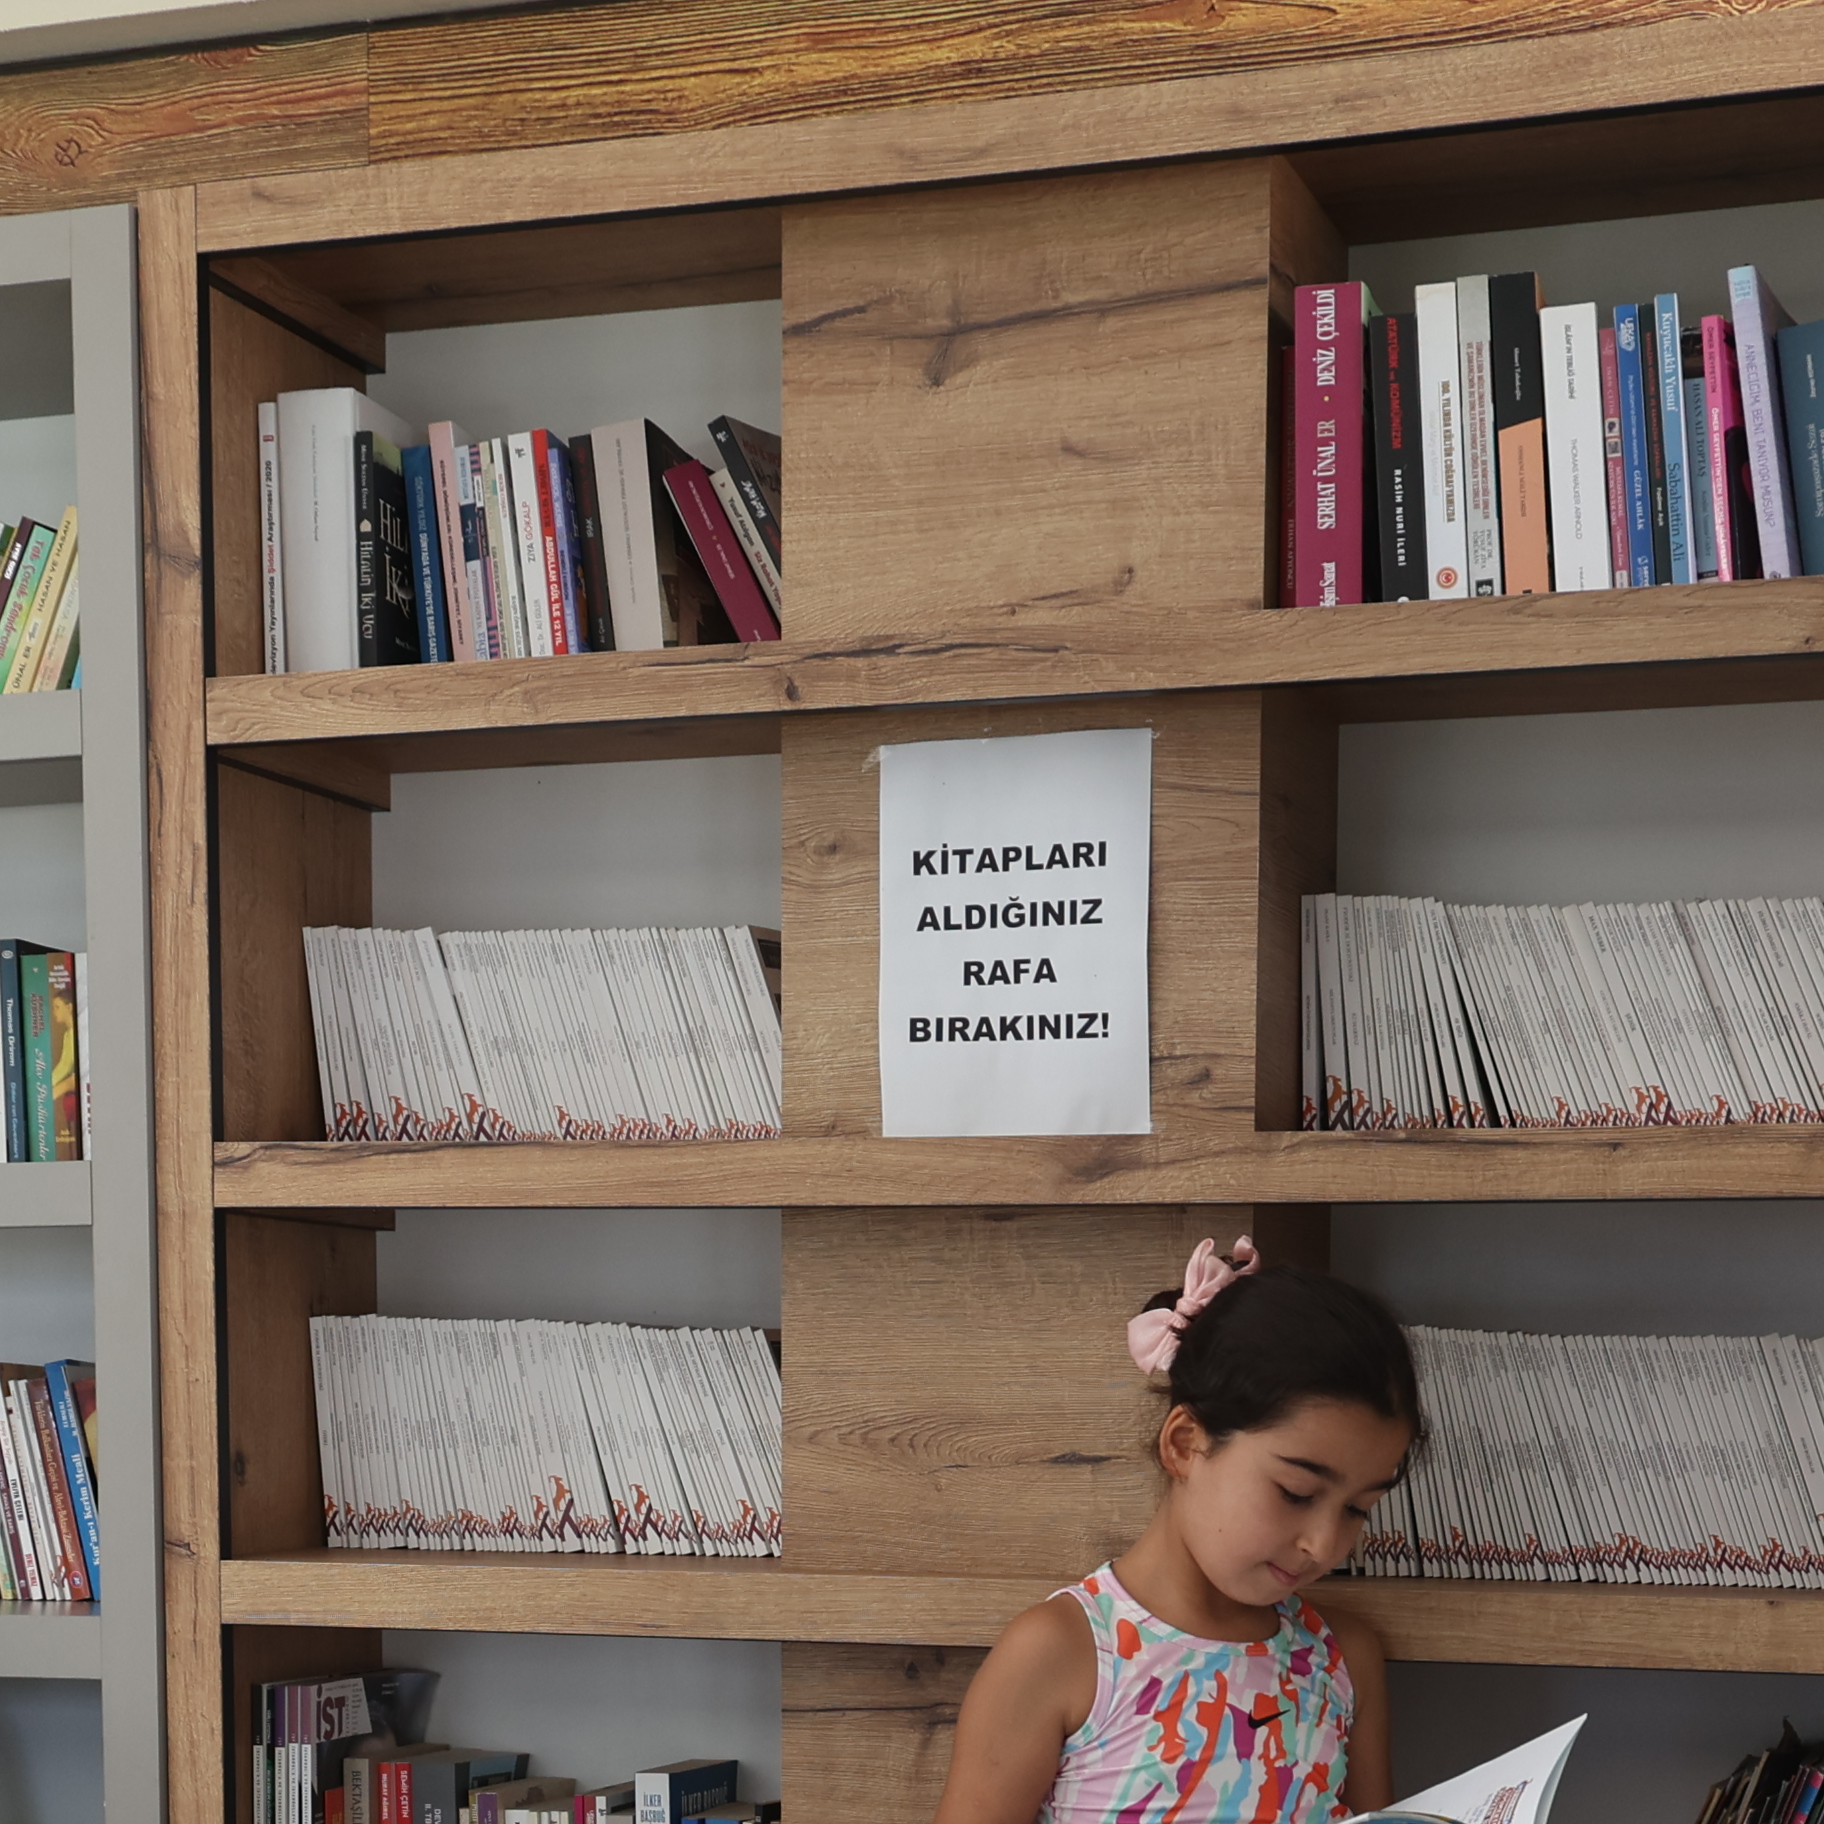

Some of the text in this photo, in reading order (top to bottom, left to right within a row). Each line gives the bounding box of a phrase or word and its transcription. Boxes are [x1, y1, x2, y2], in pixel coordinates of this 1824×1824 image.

[1311, 288, 1340, 386] DENİZ ÇEKİLDİ
[1387, 317, 1402, 449] ATATÜRK KOMÜNİZM
[1660, 312, 1679, 412] Kuyucaklı Yusuf
[1692, 383, 1708, 478] HASAN ALİ TOPTAŞ
[1711, 407, 1721, 431] ÖMER
[1312, 419, 1336, 530] SERHAT ÜNAL ER
[1570, 438, 1579, 473] THOMAS
[1754, 438, 1771, 482] TANIYOR
[521, 501, 534, 541] GÖKALP
[1393, 469, 1407, 567] RASİH NURİ İLERİ
[1633, 470, 1646, 530] GÜZEL AHLÂK
[1668, 462, 1685, 562] Sabahattin Ali
[585, 517, 594, 538] IRAK
[728, 496, 742, 519] Yusuf
[753, 550, 765, 564] Siz
[759, 563, 775, 588] Rahat
[1573, 505, 1583, 539] ARNOLD
[37, 520, 72, 613] HASAN VE HASAN
[265, 460, 278, 632] Yayınlarında Şiddet Araştırması 2020
[545, 535, 565, 646] ABDULLAH GÜL İLE 12 YIL
[13, 645, 33, 689] ÜNAL ER
[912, 841, 1107, 876] KİTAPLARI
[916, 896, 1103, 932] ALDIĞINIZ
[963, 958, 1058, 987] RAFA
[5, 997, 14, 1033] Thomas
[37, 995, 45, 1032] RACHEL
[908, 1012, 1111, 1043] BIRAKINIZ!
[71, 1453, 94, 1520] Kerim Meali
[315, 1684, 347, 1741] İST
[380, 1773, 388, 1796] MURAT
[399, 1769, 408, 1794] SEMİH
[643, 1791, 662, 1807] İLKER
[399, 1795, 410, 1818] ÇETİN
[640, 1808, 666, 1824] BAŞBUĞ
